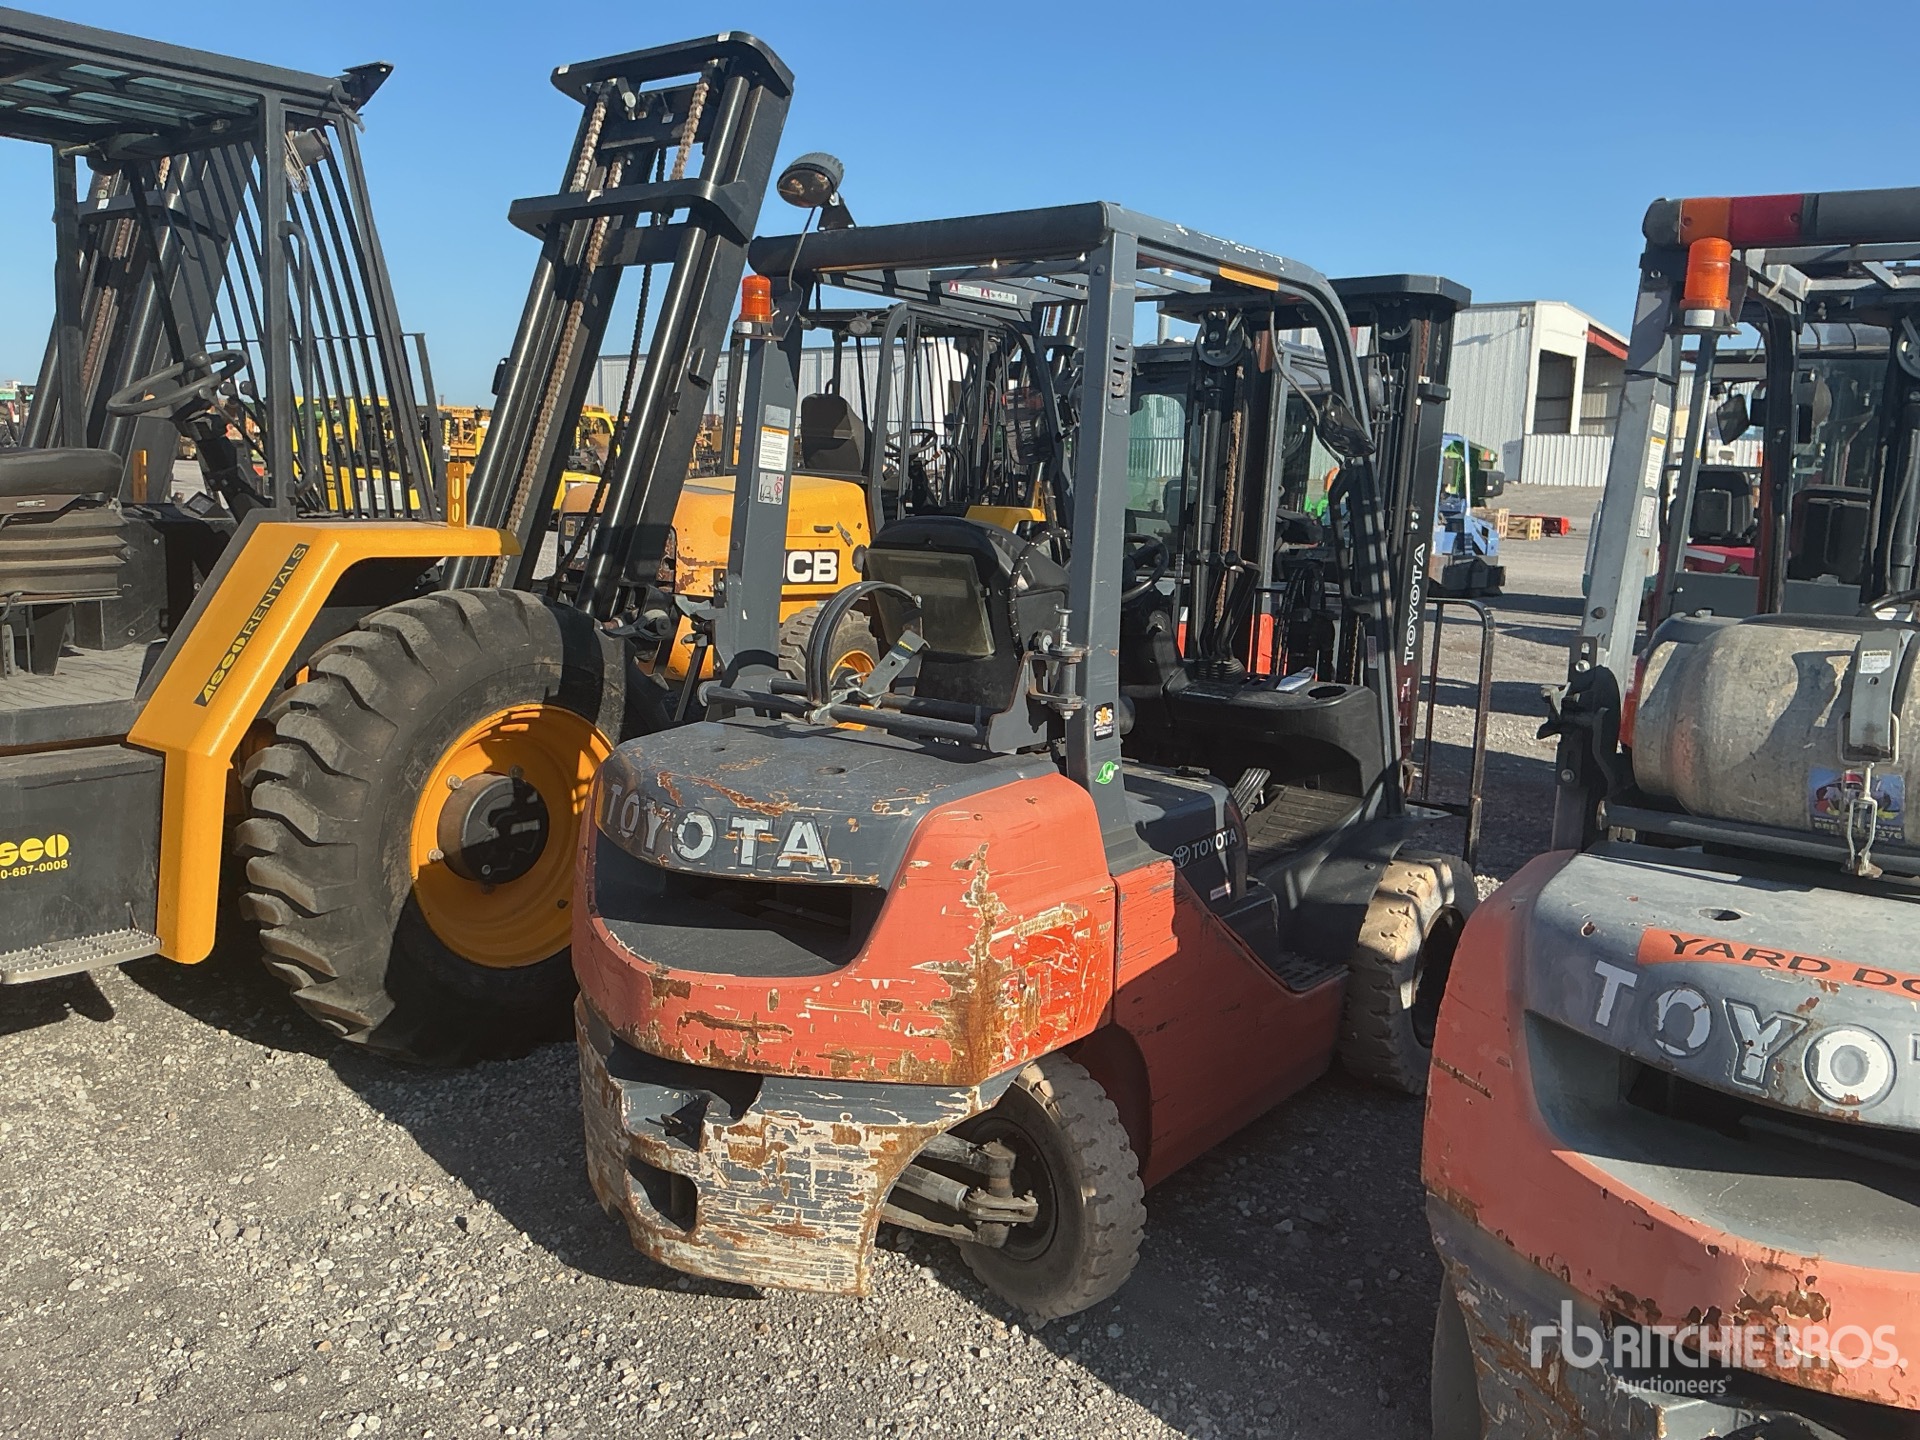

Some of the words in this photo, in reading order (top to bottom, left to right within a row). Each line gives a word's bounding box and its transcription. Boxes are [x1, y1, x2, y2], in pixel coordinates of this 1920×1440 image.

[242, 546, 306, 635] RENTALS
[782, 550, 838, 582] CB
[1403, 542, 1426, 666] TOYOTA
[1095, 706, 1113, 726] SAS
[606, 783, 829, 871] TOYOTA
[1191, 828, 1237, 859] TOYOTA
[1669, 934, 1832, 973] YARD
[1594, 959, 1920, 1108] TOYO
